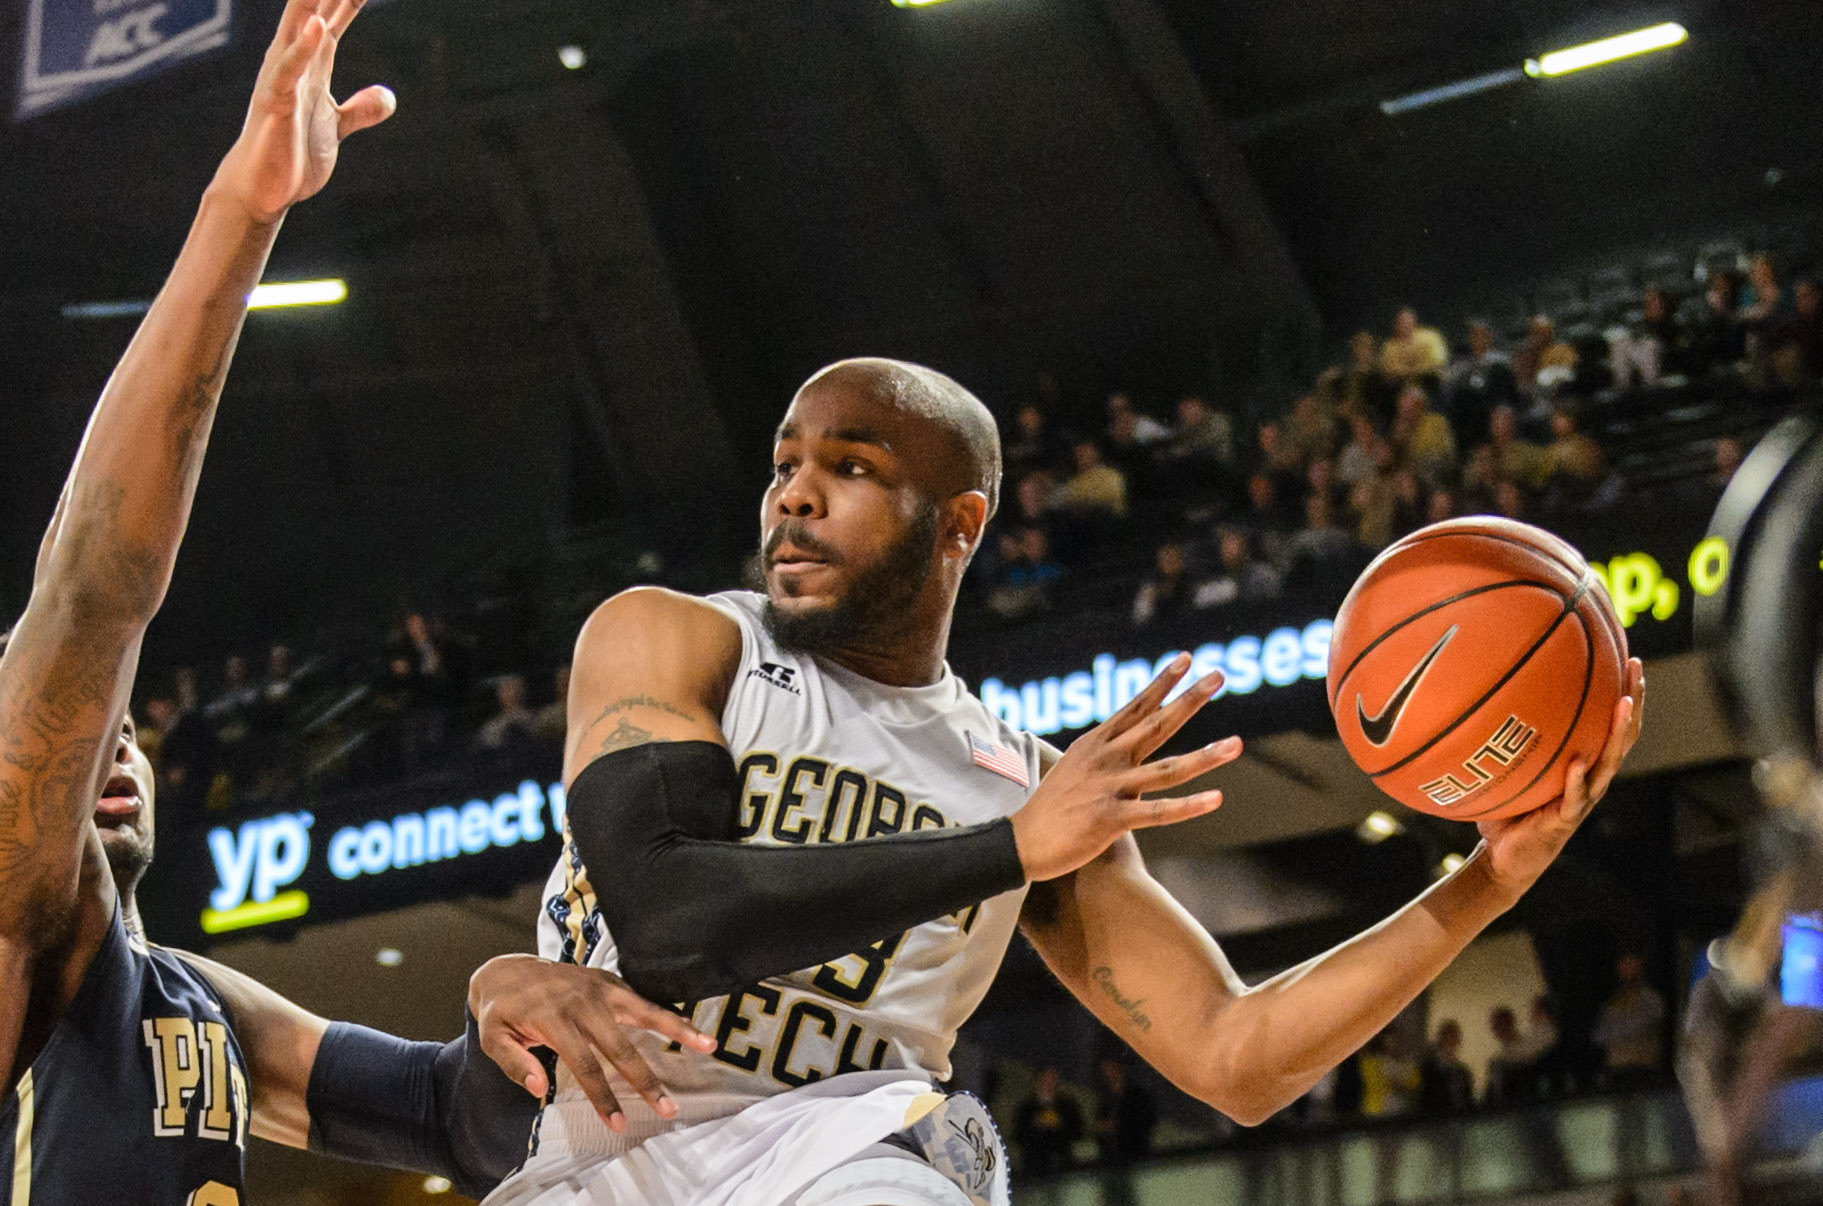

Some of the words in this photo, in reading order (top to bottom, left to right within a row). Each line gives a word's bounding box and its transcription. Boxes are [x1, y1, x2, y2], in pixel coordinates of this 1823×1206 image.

[84, 3, 170, 67] ACC
[736, 750, 966, 846] GEOR
[1418, 713, 1537, 806] ELITE
[207, 812, 311, 912] yp
[328, 779, 546, 881] connect
[664, 985, 889, 1088] ECH
